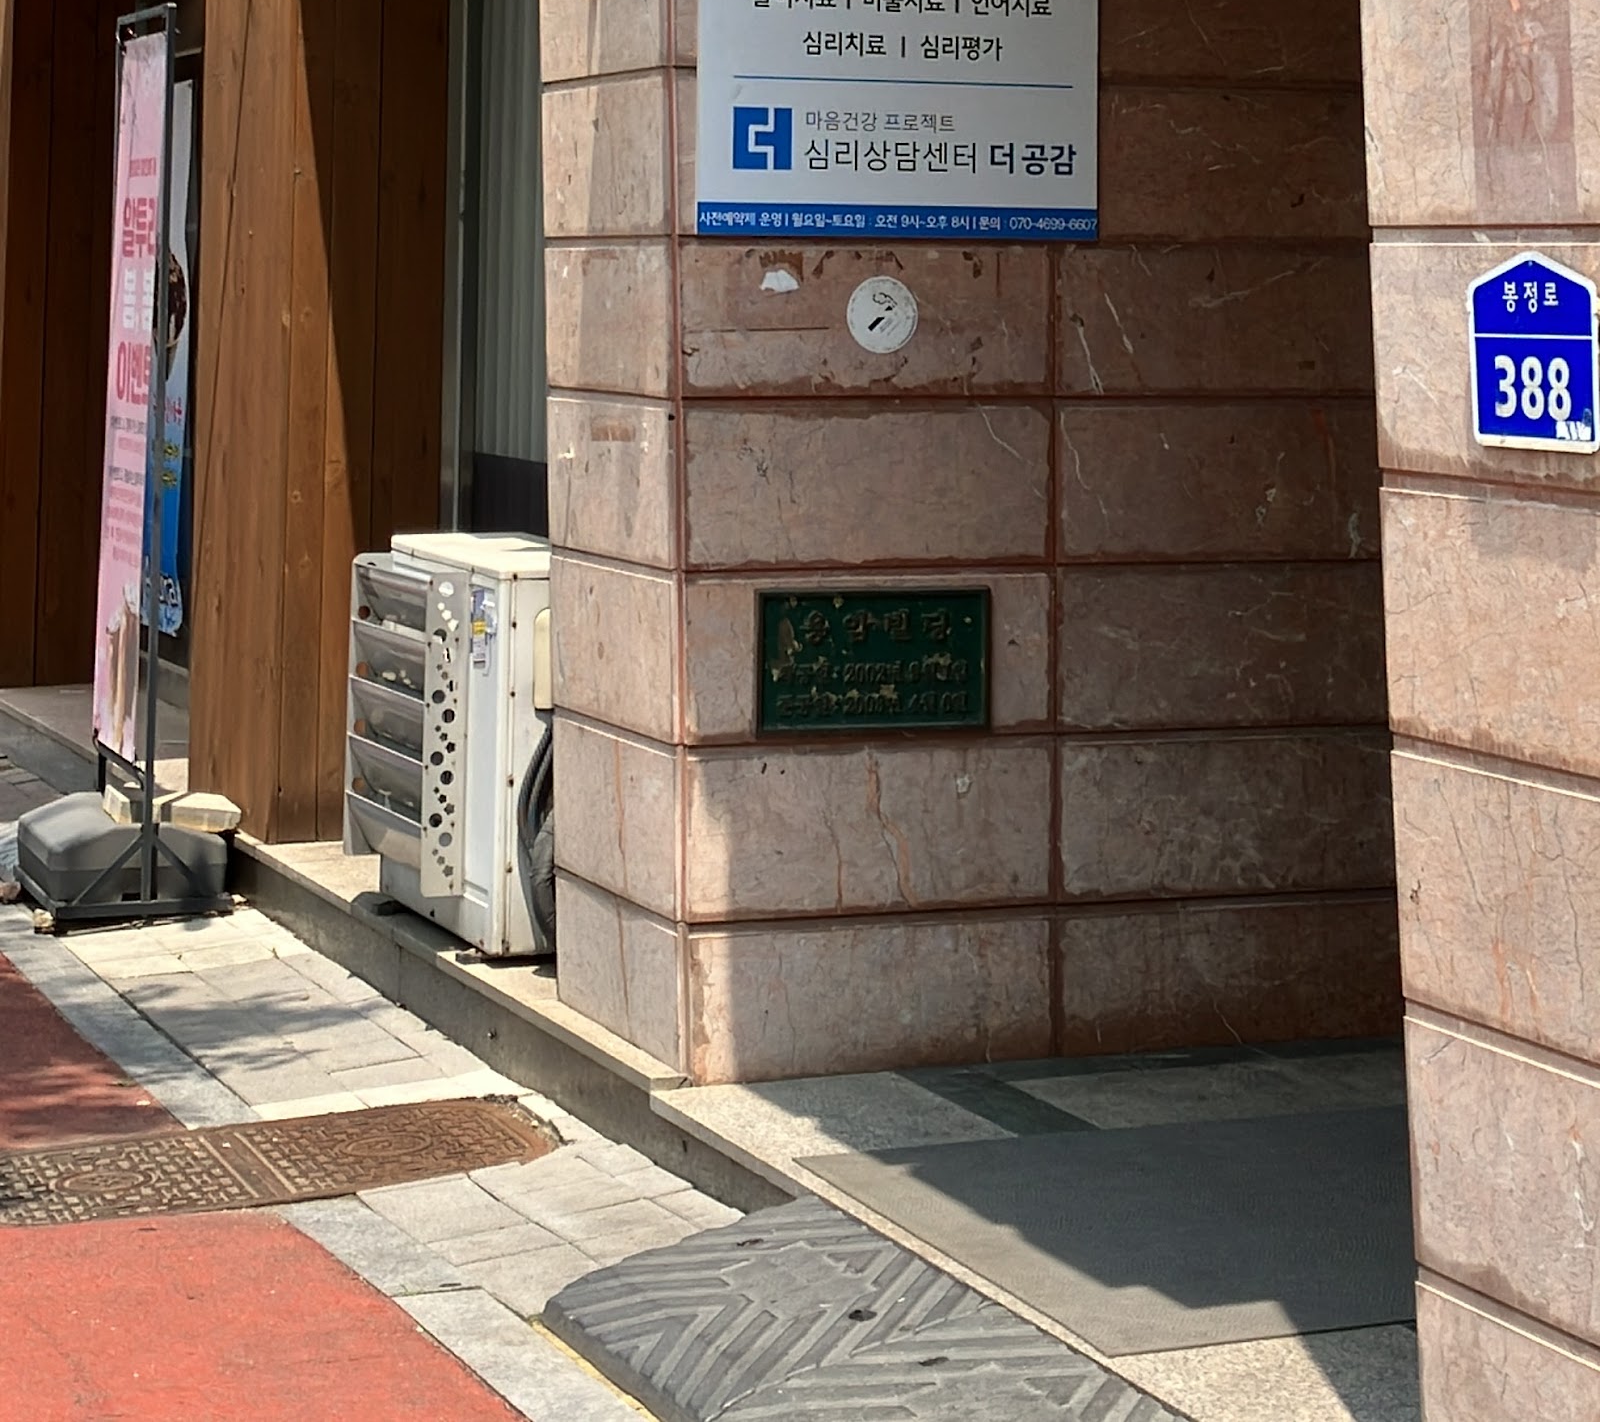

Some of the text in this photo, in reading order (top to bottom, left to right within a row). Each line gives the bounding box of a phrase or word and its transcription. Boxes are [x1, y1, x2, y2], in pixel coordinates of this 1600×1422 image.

[802, 30, 1004, 63] 심리치료 심리평가
[805, 110, 956, 135] 마음건강 프로젝트
[804, 138, 977, 175] 심리상담센터
[699, 211, 756, 227] 사전예약제
[758, 212, 782, 228] 운영
[951, 215, 970, 231] 8시
[1502, 281, 1559, 313] 봉정로
[1494, 354, 1572, 422] 388
